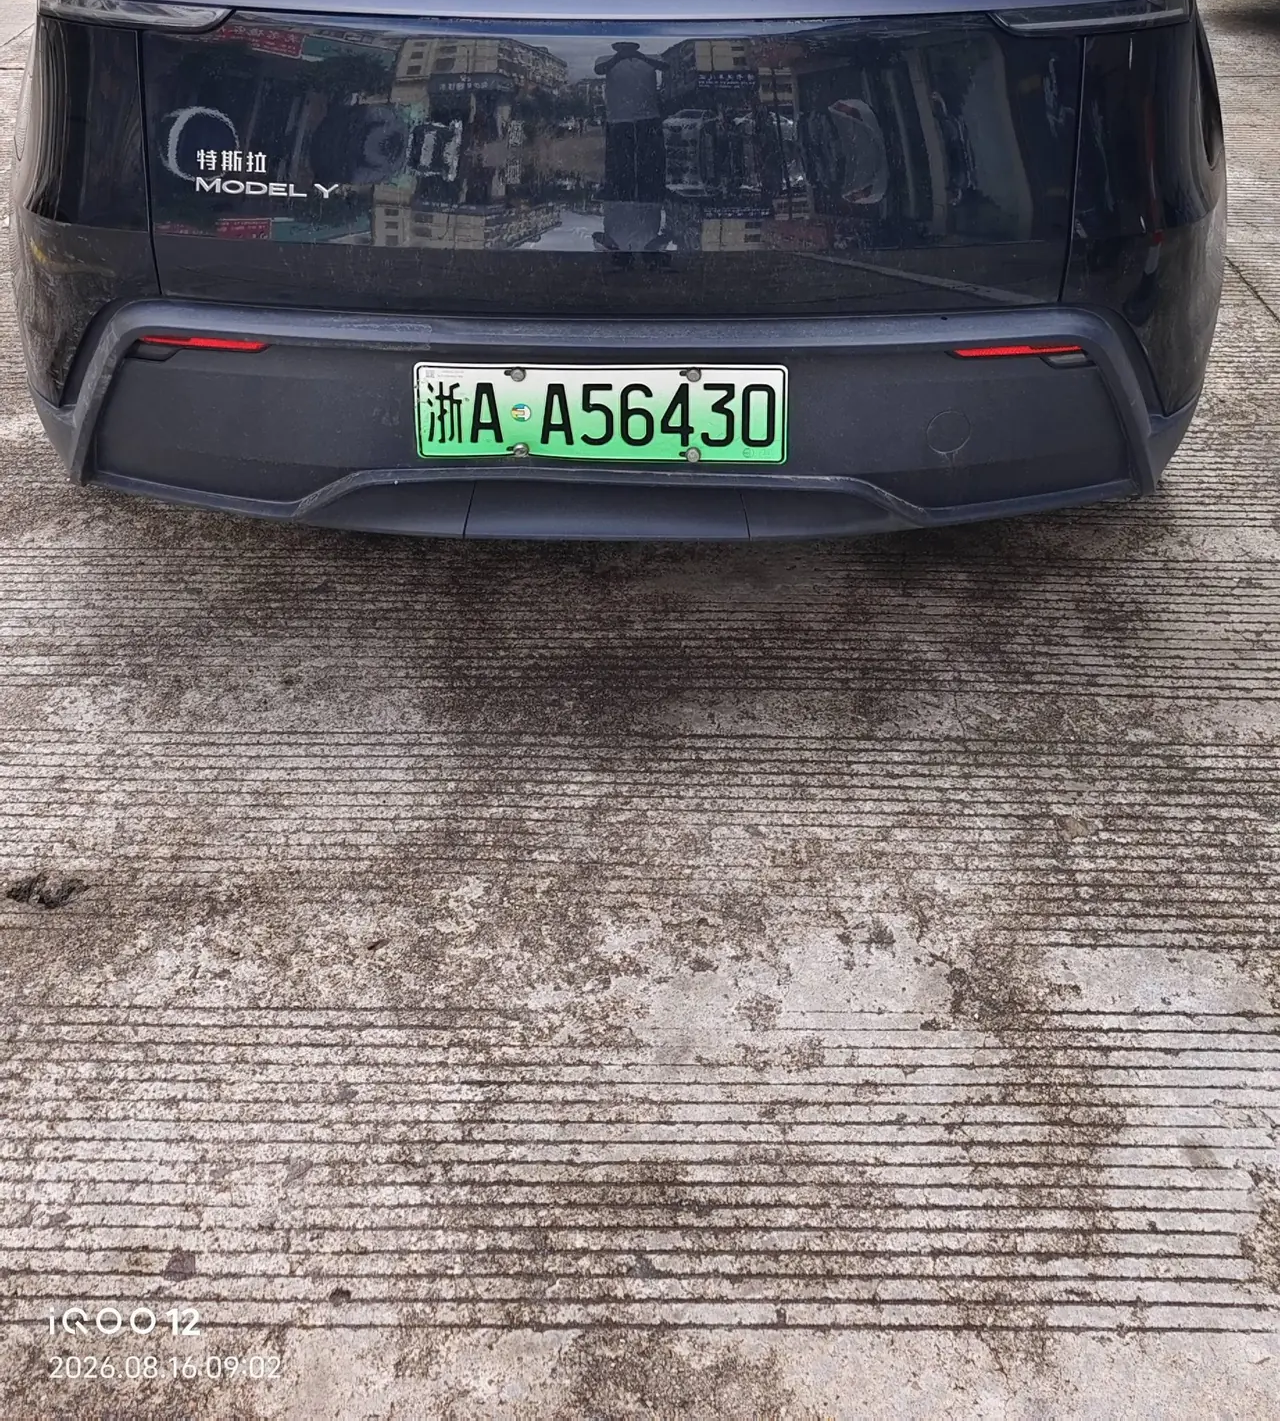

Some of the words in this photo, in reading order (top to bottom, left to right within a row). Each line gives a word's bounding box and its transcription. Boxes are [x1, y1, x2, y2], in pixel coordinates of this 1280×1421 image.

[196, 149, 267, 173] 特斯拉
[195, 177, 307, 198] MODEL
[313, 183, 339, 199] Y
[540, 382, 776, 448] A56430
